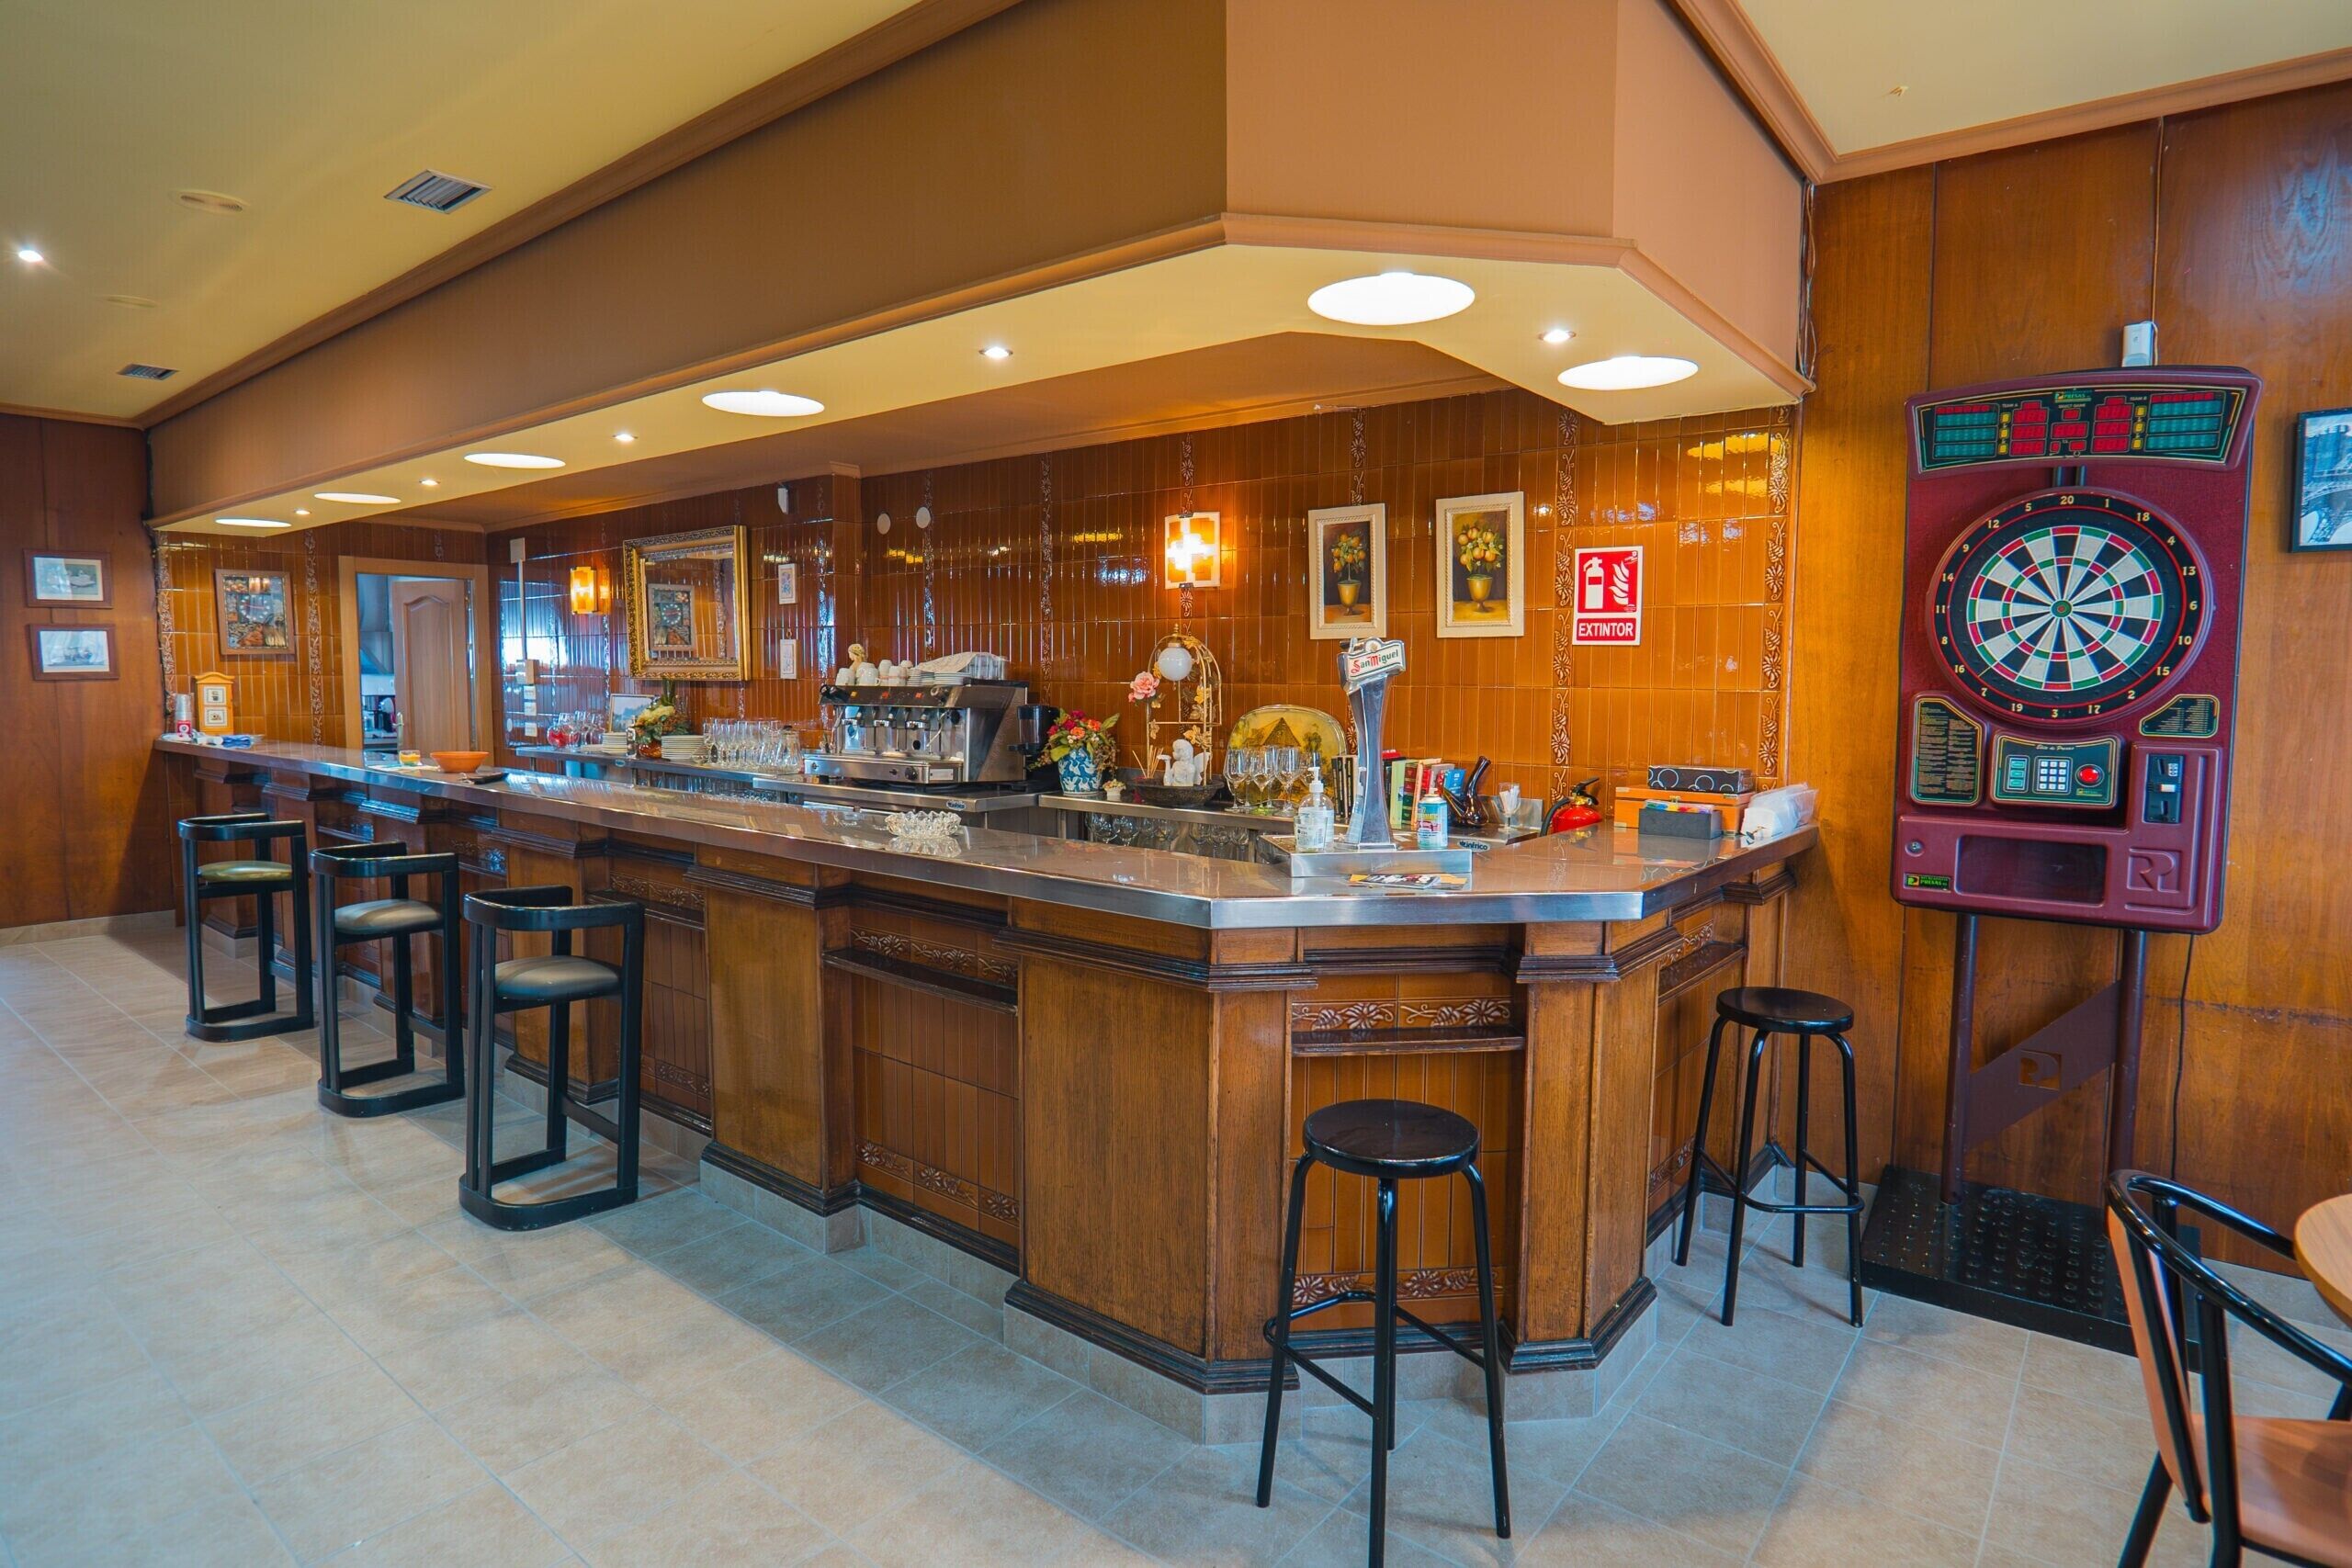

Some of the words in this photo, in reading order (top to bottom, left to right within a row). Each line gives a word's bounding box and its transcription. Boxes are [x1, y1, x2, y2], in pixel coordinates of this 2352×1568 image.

[2060, 495, 2074, 505] 20
[2105, 498, 2109, 508] 1
[2025, 502, 2032, 512] 5
[2136, 512, 2150, 522] 18
[1988, 519, 2000, 529] 12
[2166, 536, 2176, 546] 4
[1962, 544, 1970, 553] 9
[2183, 566, 2197, 576] 13
[1942, 572, 1954, 582] 14
[1936, 604, 1946, 614] 11
[2189, 601, 2198, 611] 6
[1578, 622, 1634, 637] EXTINTOR
[1941, 636, 1948, 645] 8
[2178, 636, 2192, 646] 10
[1351, 659, 1371, 674] San
[1366, 649, 1398, 667] Miguel
[1954, 664, 1965, 673] 16
[2156, 666, 2170, 676] 15
[1981, 687, 1988, 697] 7
[2127, 690, 2136, 700] 2
[2011, 703, 2024, 712] 19
[2052, 708, 2059, 717] 3
[2087, 705, 2101, 715] 17
[1465, 841, 1488, 851] infrico
